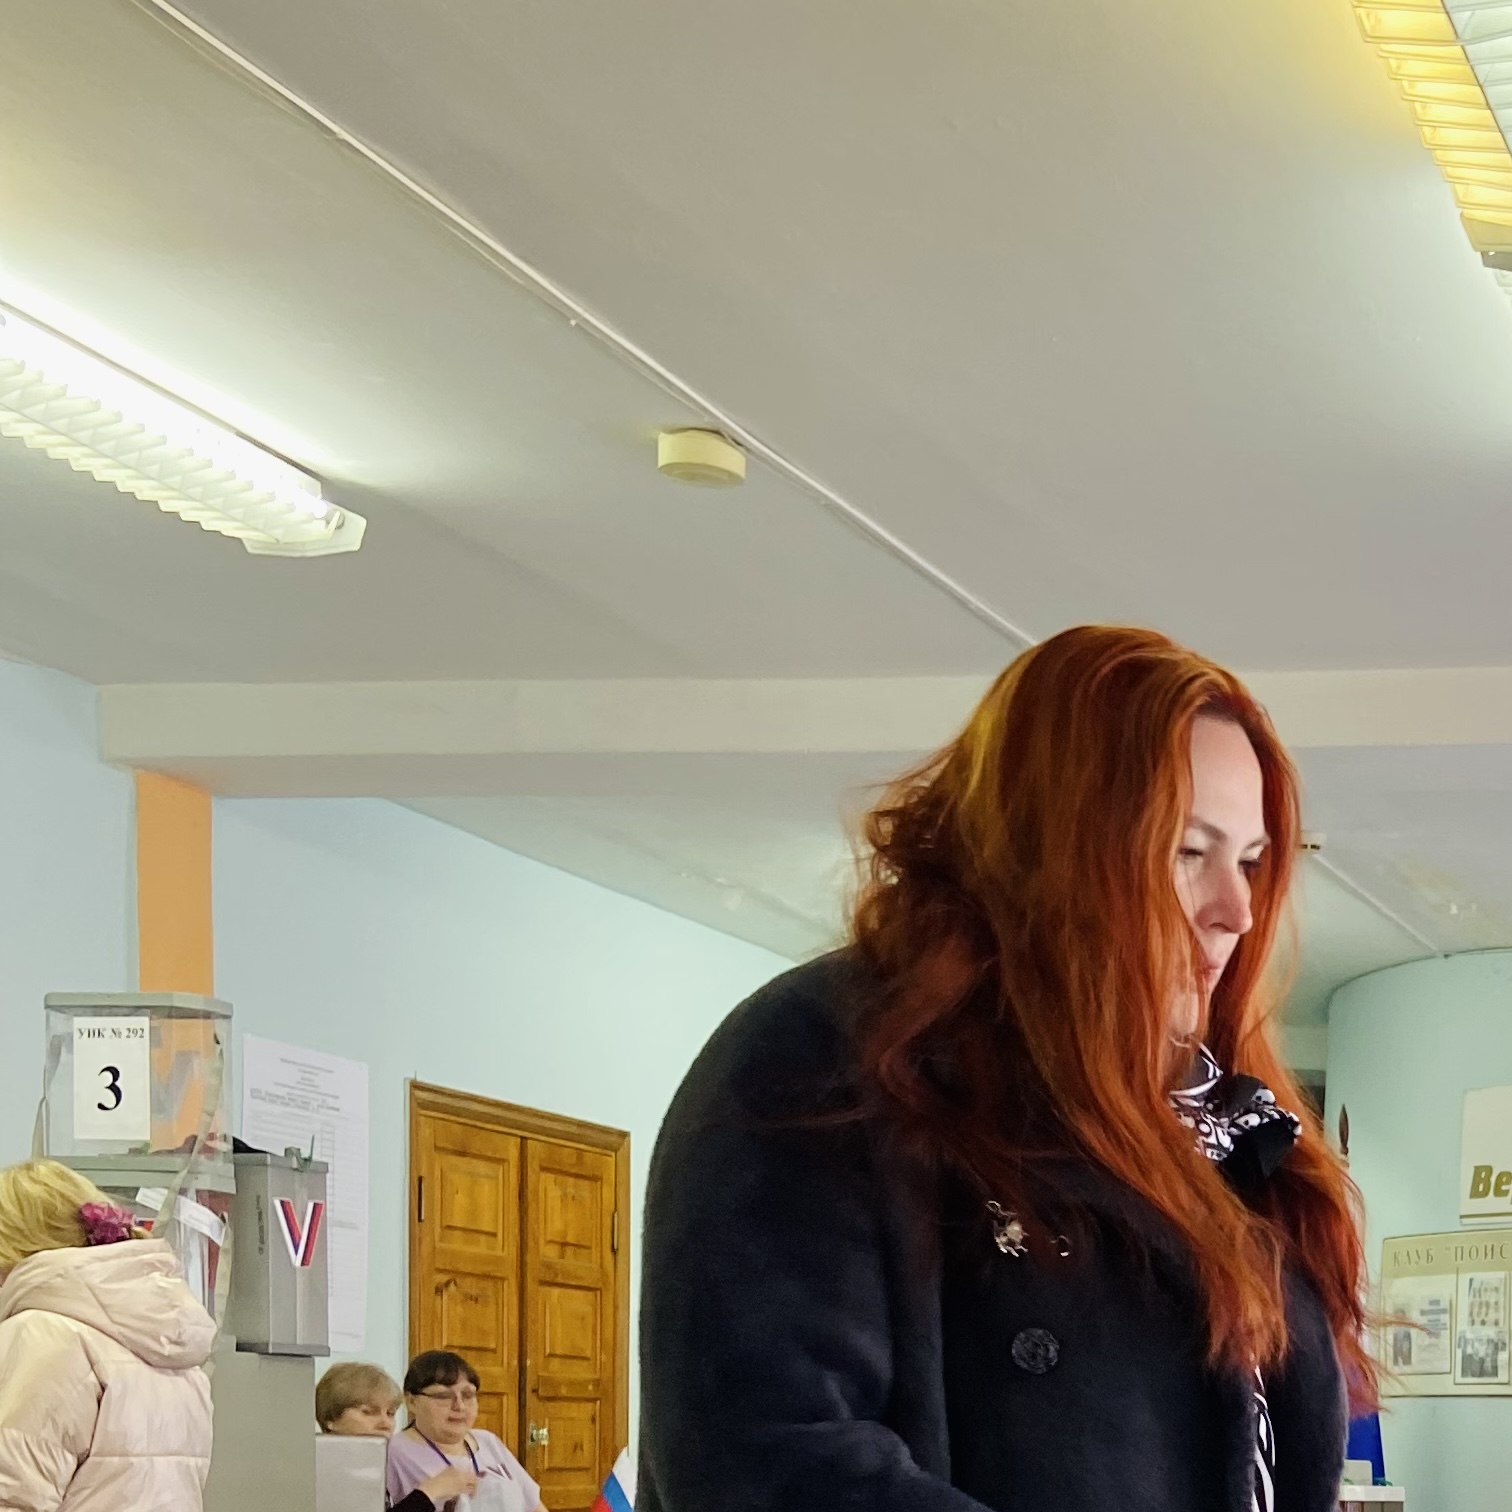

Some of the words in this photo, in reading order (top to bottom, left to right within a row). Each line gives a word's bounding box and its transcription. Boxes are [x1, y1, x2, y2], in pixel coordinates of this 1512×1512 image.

[77, 1027, 106, 1039] УИК
[125, 1027, 145, 1039] 292
[97, 1065, 122, 1111] 3
[1393, 1247, 1435, 1267] КЛУБ
